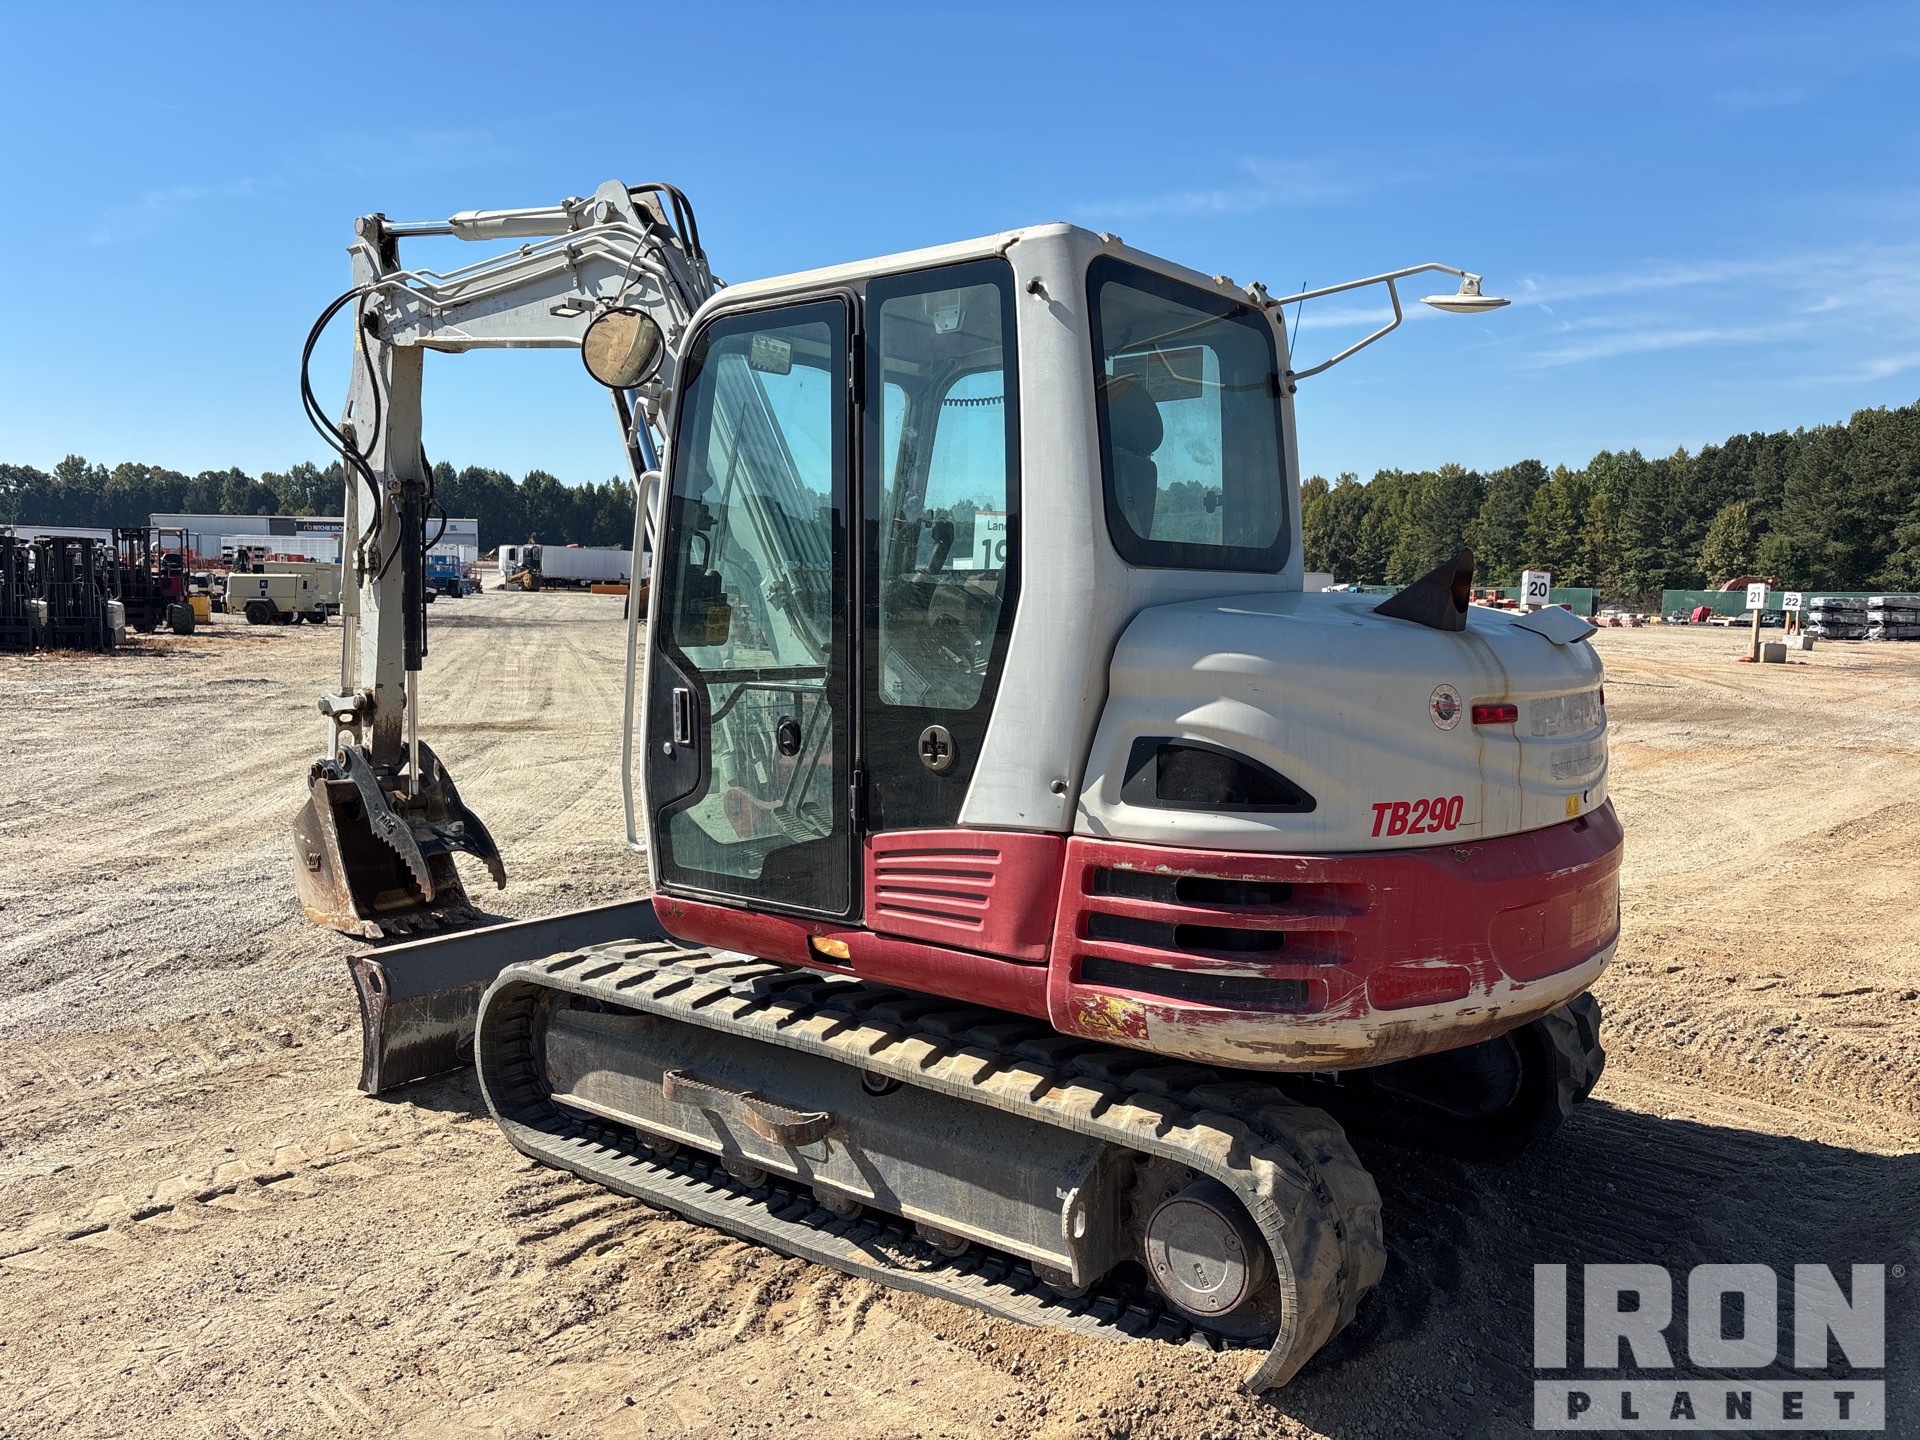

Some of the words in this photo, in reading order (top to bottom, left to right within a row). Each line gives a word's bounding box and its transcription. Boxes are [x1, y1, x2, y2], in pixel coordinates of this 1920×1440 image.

[987, 519, 1006, 532] Lan
[1529, 581, 1547, 597] 20
[1750, 591, 1761, 603] 21
[1784, 597, 1799, 607] 22
[1371, 795, 1464, 838] TB290
